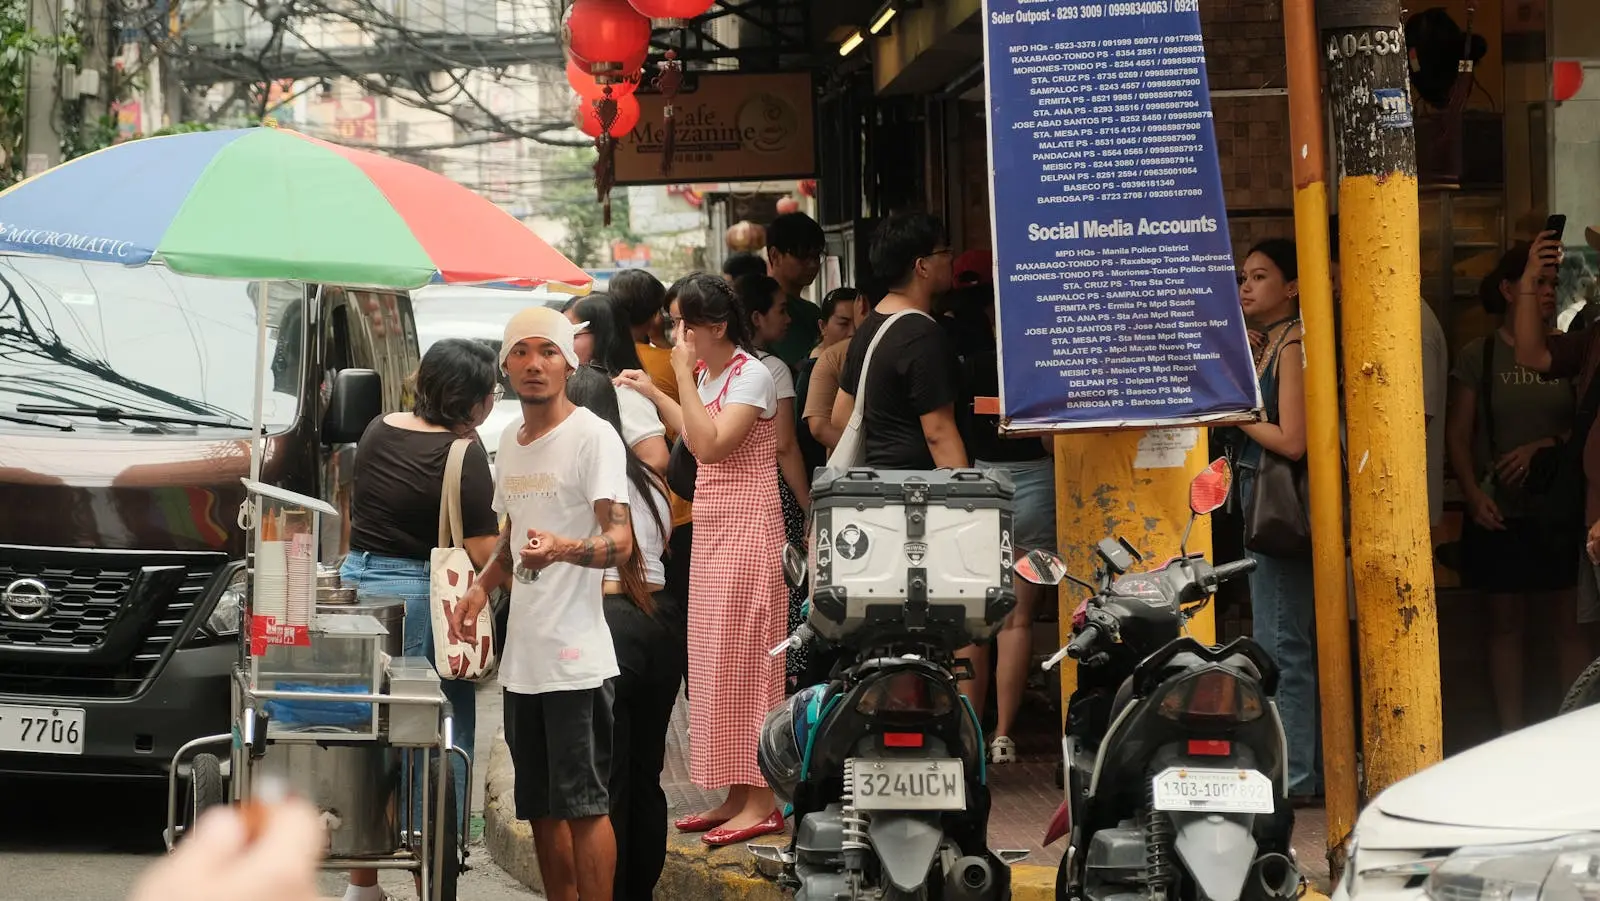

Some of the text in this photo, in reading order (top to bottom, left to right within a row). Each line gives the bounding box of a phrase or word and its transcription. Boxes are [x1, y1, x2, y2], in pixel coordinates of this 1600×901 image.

[992, 11, 1014, 23] Soler
[1016, 9, 1050, 24] Outpost
[1080, 6, 1102, 17] 3009
[1010, 44, 1028, 52] MPD
[1327, 30, 1401, 61] A0433
[1012, 52, 1095, 63] RAXABAGO-TONDO
[1014, 63, 1094, 74] MORIONES-TONDO
[1031, 85, 1078, 94] SAMPALOC
[1080, 84, 1092, 92] PS
[1039, 96, 1072, 104] ERMITA
[1054, 107, 1073, 115] ANA
[1037, 119, 1062, 127] ABAD
[1064, 117, 1100, 126] SANTOS
[628, 121, 756, 144] Mezanine
[1054, 129, 1080, 137] MESA
[1039, 140, 1074, 148] MALATE
[1033, 151, 1081, 160] PANDACAN
[1043, 162, 1072, 170] MEISIC
[1041, 172, 1089, 182] DELPAN PS
[1064, 183, 1101, 191] BASECO
[1038, 195, 1082, 204] BARBOSA
[1028, 215, 1217, 241] Social Media Accounts
[6, 227, 134, 257] MICROMATIC
[1102, 247, 1129, 255] Manila
[1158, 244, 1189, 252] District
[1016, 259, 1100, 270] RAXABAGO-TONDO
[1120, 256, 1162, 266] Raxabago
[1010, 270, 1090, 281] MORIONES-TONDO
[1111, 266, 1178, 276] Moriones-Tondo
[1037, 293, 1085, 302] SAMPALOC
[1106, 290, 1155, 298] SAMPALOC
[1178, 287, 1213, 295] MANILA
[1055, 304, 1088, 312] ERMITA
[1149, 300, 1167, 309] Mpd
[1077, 314, 1096, 322] ANA
[1150, 311, 1168, 320] Mpd
[1025, 327, 1048, 335] JOSE
[1049, 326, 1075, 334] ABAD
[1076, 324, 1112, 332] SANTOS
[1178, 320, 1207, 328] Santos
[1209, 320, 1228, 328] Mpd
[1073, 336, 1098, 344] MESA
[1134, 333, 1156, 341] Mesa
[1158, 332, 1176, 341] Mpd
[1177, 331, 1202, 339] React
[1053, 347, 1088, 355] MALATE
[1109, 346, 1127, 354] Mpd
[1035, 358, 1084, 367] PANDACAN
[1105, 355, 1146, 364] Pandacan
[1148, 354, 1166, 363] Mpd
[1168, 353, 1191, 361] React
[1193, 352, 1220, 360] Manila
[1060, 368, 1090, 376] MEISIC
[1153, 365, 1171, 374] Mpd
[1173, 364, 1196, 372] React
[1070, 379, 1105, 387] DELPAN
[1125, 377, 1154, 386] Delpan
[1170, 375, 1188, 384] Mpd
[1068, 389, 1105, 397] BASECO
[1126, 387, 1157, 395] Baseco
[1172, 386, 1191, 394] Mpd
[1067, 400, 1111, 408] BARBOSA
[1131, 397, 1166, 405] Barbosa
[7, 596, 48, 605] NISSAN
[21, 717, 79, 744] 7706
[860, 773, 957, 797] 324UCW
